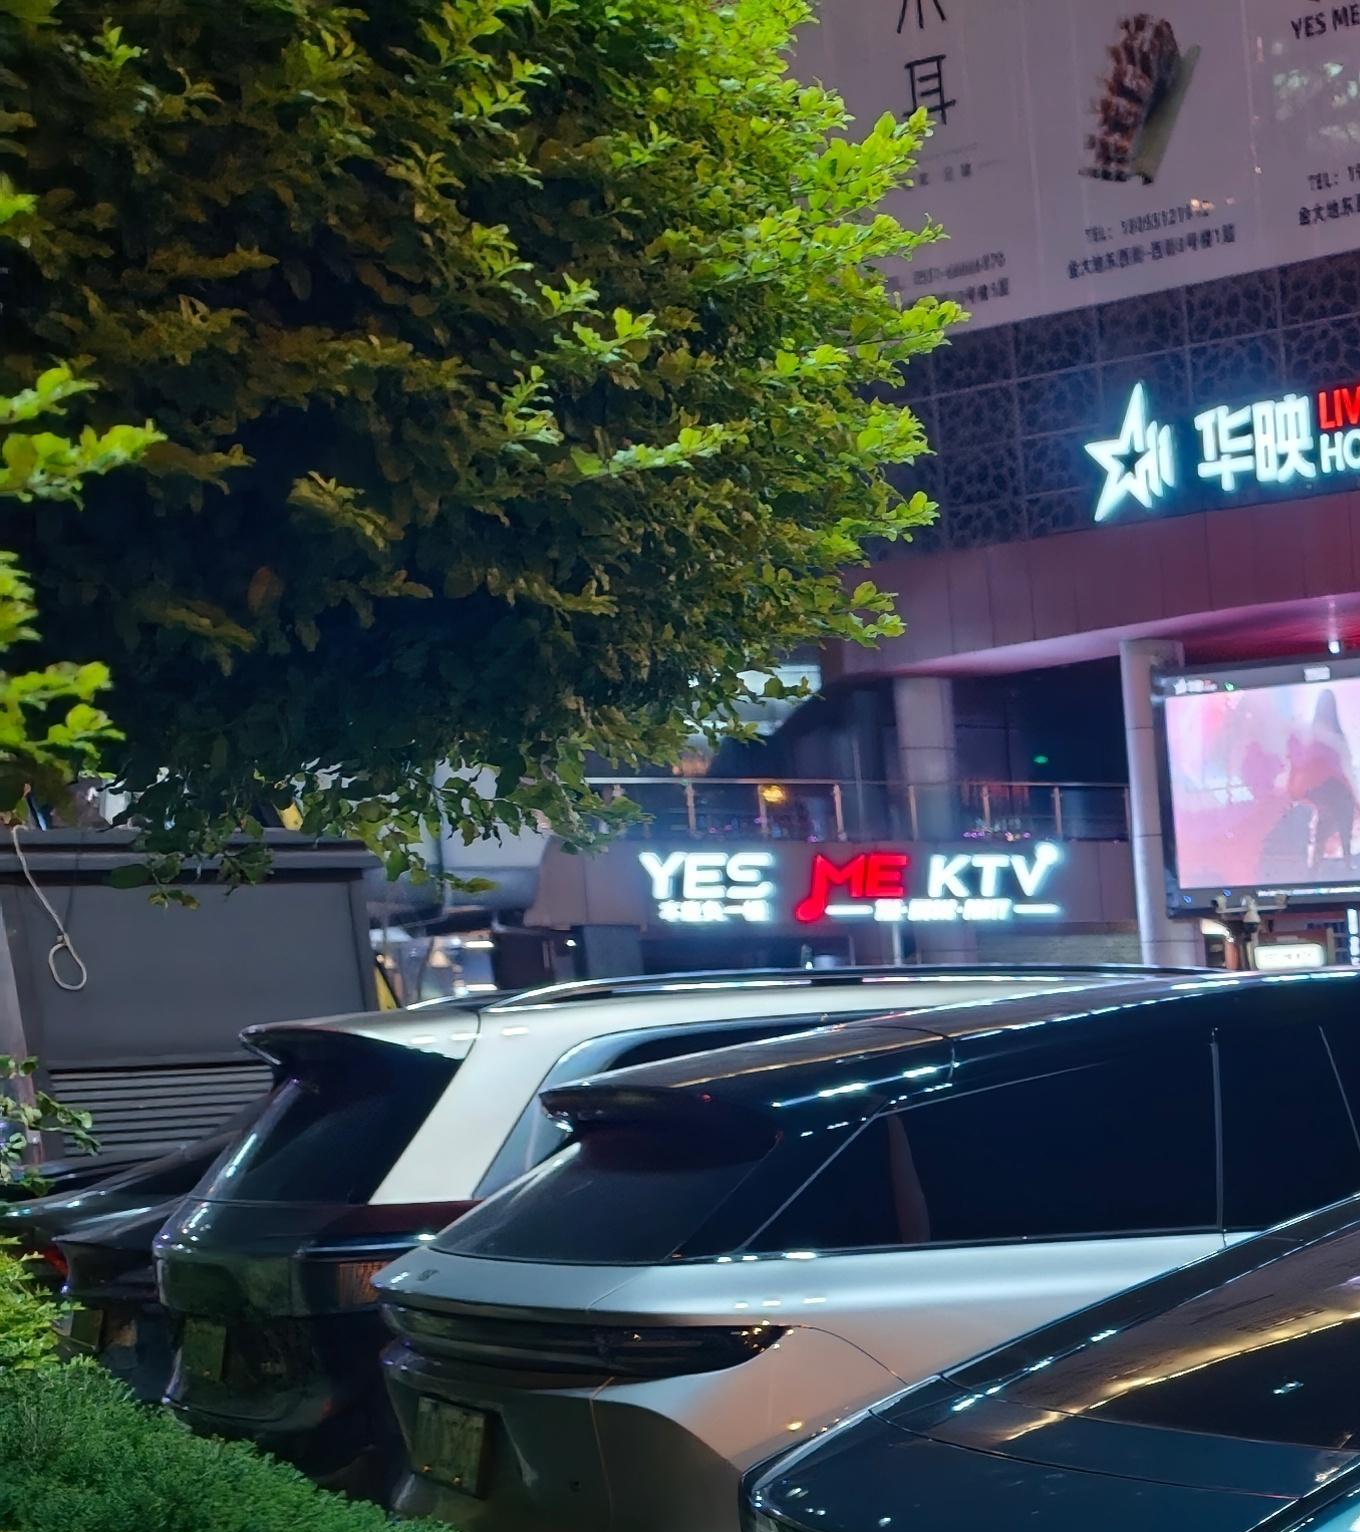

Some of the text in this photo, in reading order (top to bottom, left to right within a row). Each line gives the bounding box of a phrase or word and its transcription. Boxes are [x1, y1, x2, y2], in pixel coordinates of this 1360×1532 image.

[1290, 12, 1327, 39] YES
[1194, 393, 1316, 492] 华映
[640, 842, 1061, 922] YES ME KTV
